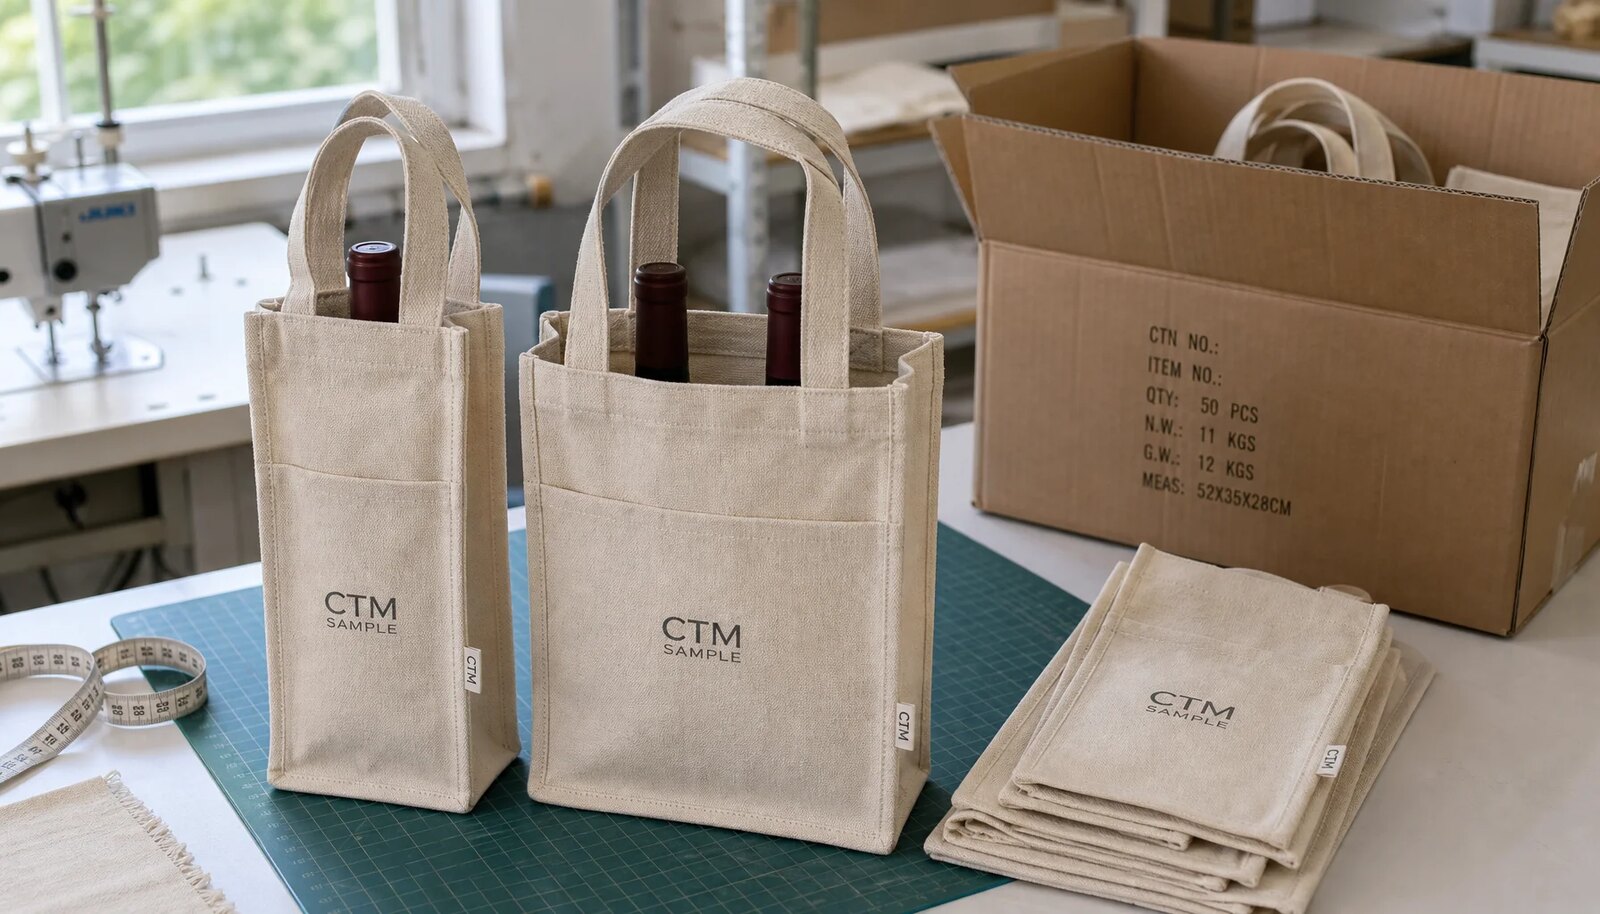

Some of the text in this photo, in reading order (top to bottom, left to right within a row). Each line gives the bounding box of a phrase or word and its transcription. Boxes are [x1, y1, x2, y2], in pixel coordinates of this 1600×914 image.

[1150, 325, 1219, 355] CTN NO.:
[1148, 356, 1222, 387] ITEM NO.:
[1146, 386, 1259, 424] QTY: 50 PCS
[1145, 415, 1256, 452] N.W.: 11 KGS
[1143, 444, 1254, 481] G.W.: 12 KGS
[1142, 472, 1292, 516] MEAS: 52X35X28CM
[325, 591, 397, 620] CTM
[326, 617, 397, 635] SAMPLE
[662, 616, 741, 648] CTM
[663, 643, 741, 663] SAMPLE
[466, 655, 477, 685] CTM
[1145, 705, 1229, 730] SAMPLE
[1150, 691, 1236, 720] CTM
[898, 711, 910, 741] CTM
[1321, 749, 1339, 769] CTM
